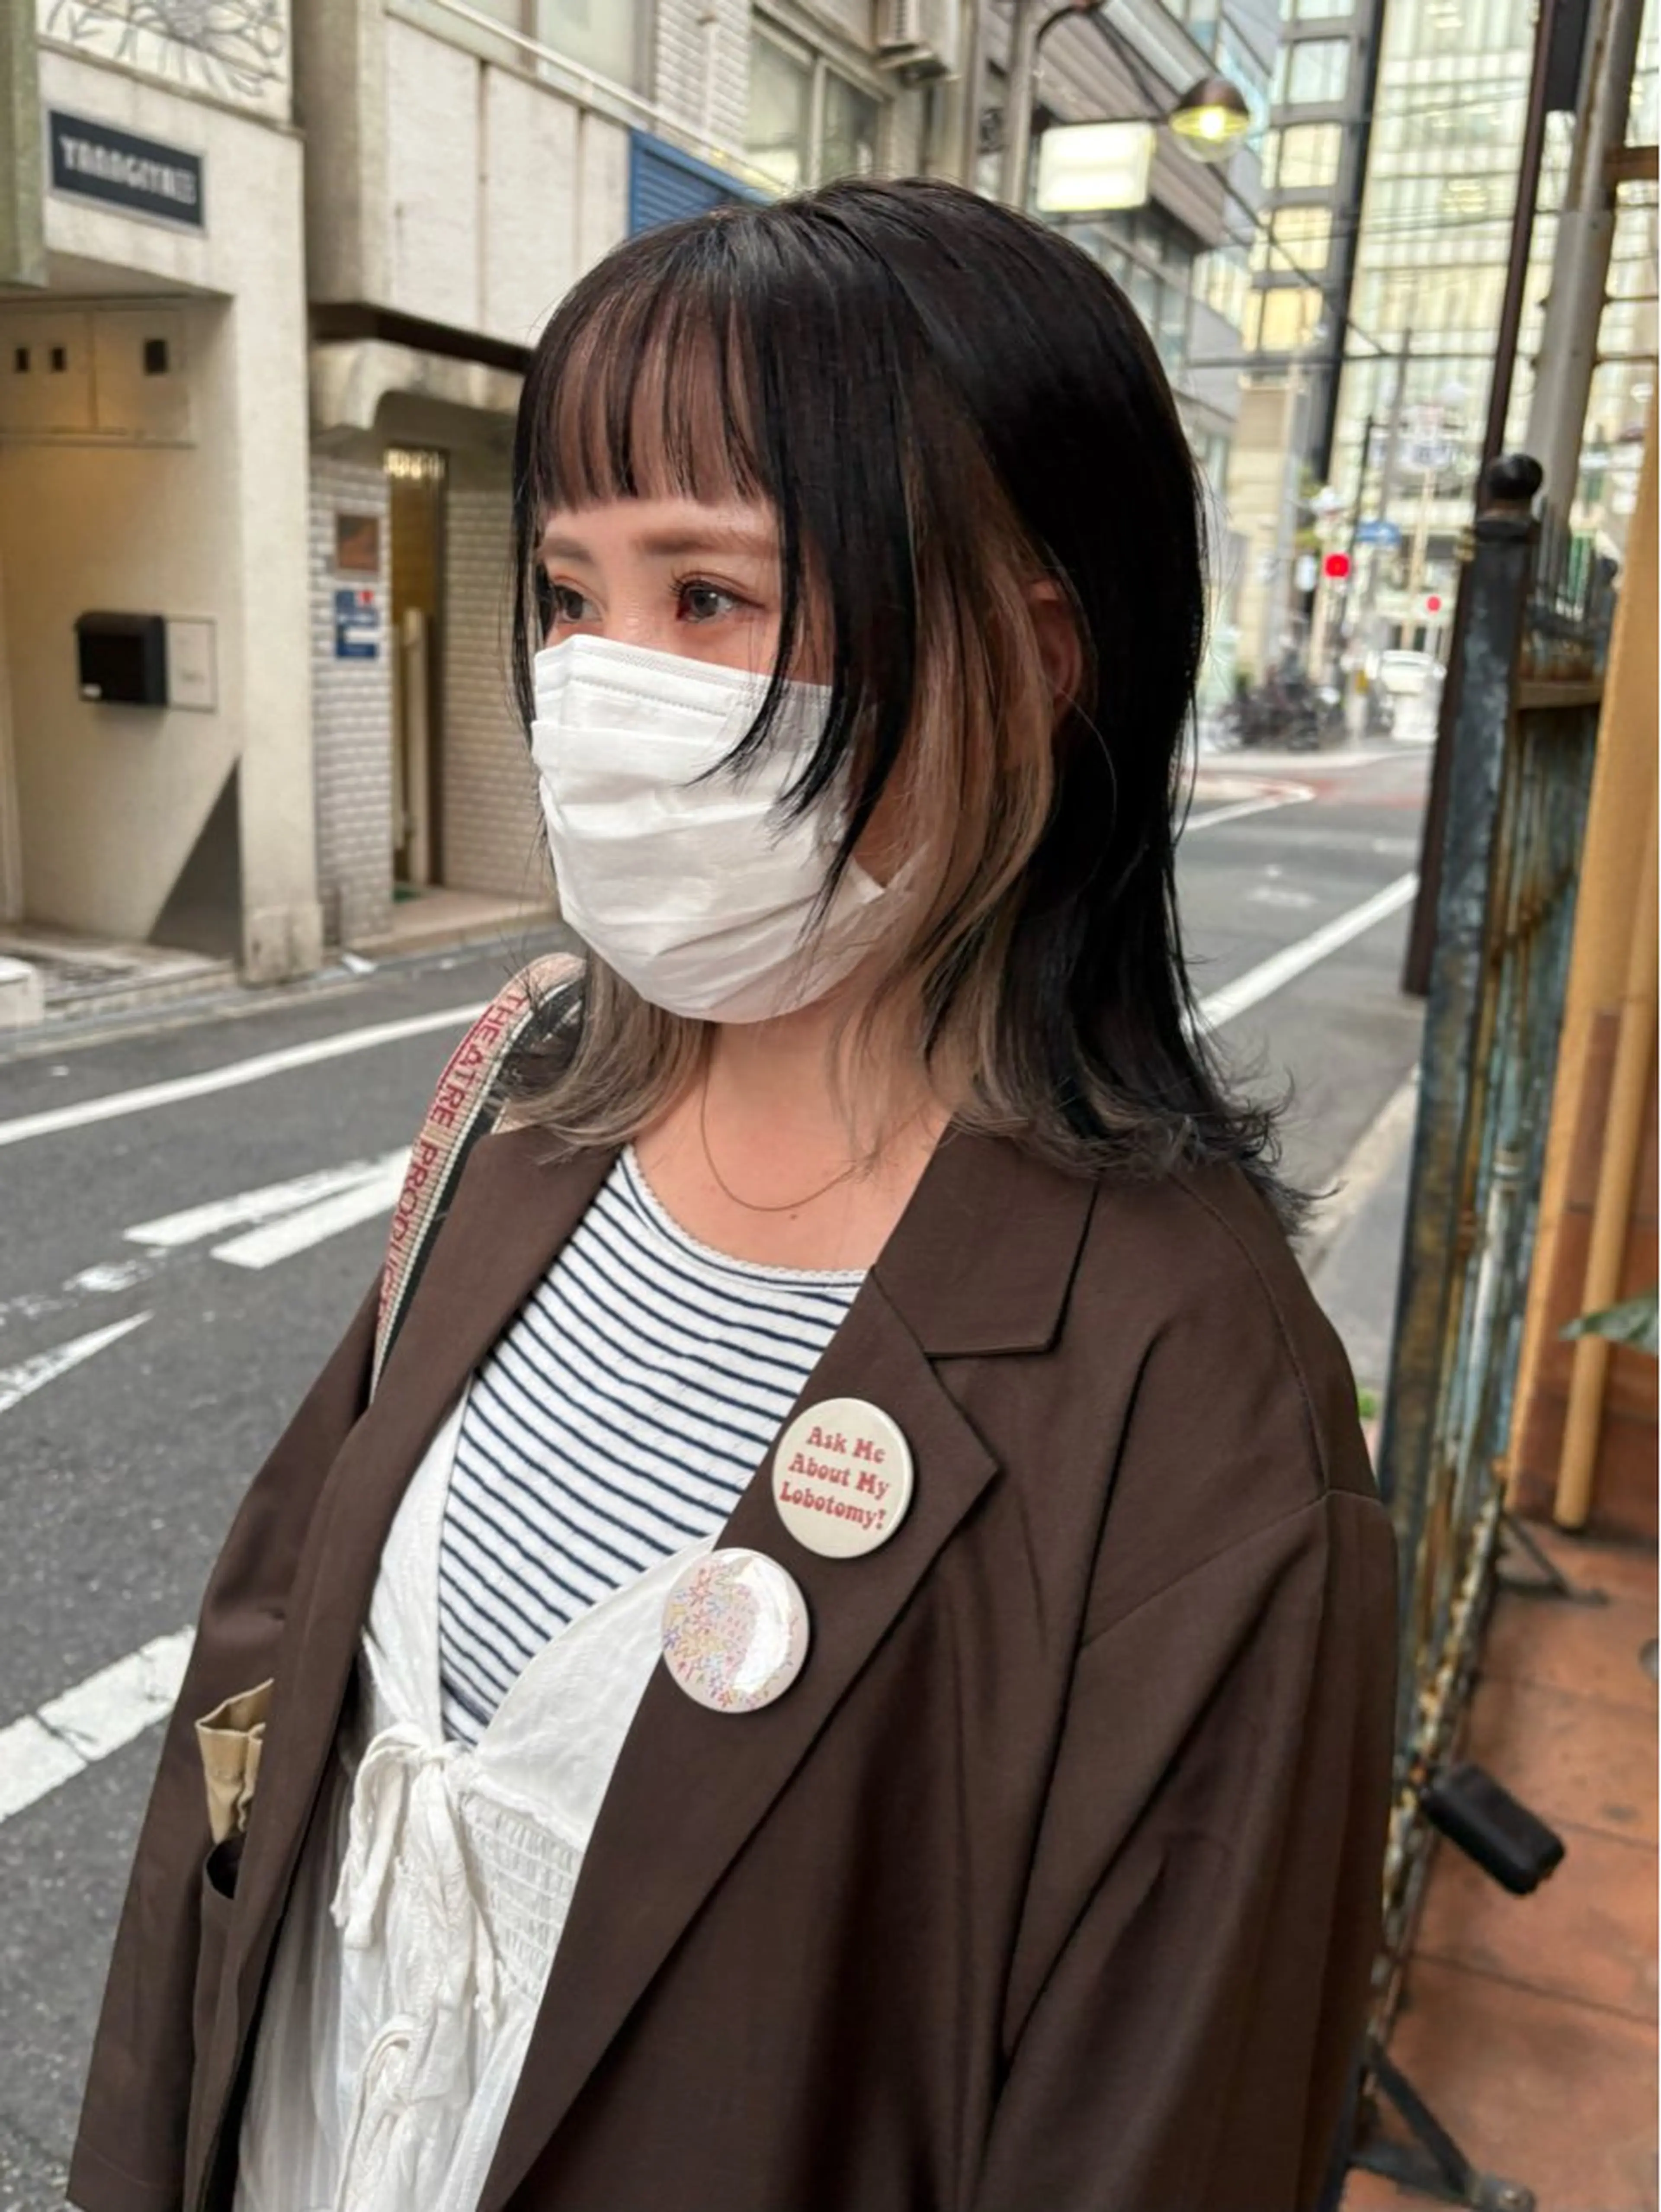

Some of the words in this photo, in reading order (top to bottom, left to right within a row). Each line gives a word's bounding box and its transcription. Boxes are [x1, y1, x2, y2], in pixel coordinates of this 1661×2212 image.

[430, 994, 528, 1128] THEATRE
[806, 1426, 847, 1454] Ask
[852, 1438, 886, 1464] Me
[788, 1452, 850, 1487] About
[855, 1471, 890, 1500] My
[779, 1481, 886, 1530] Lobotomy!
